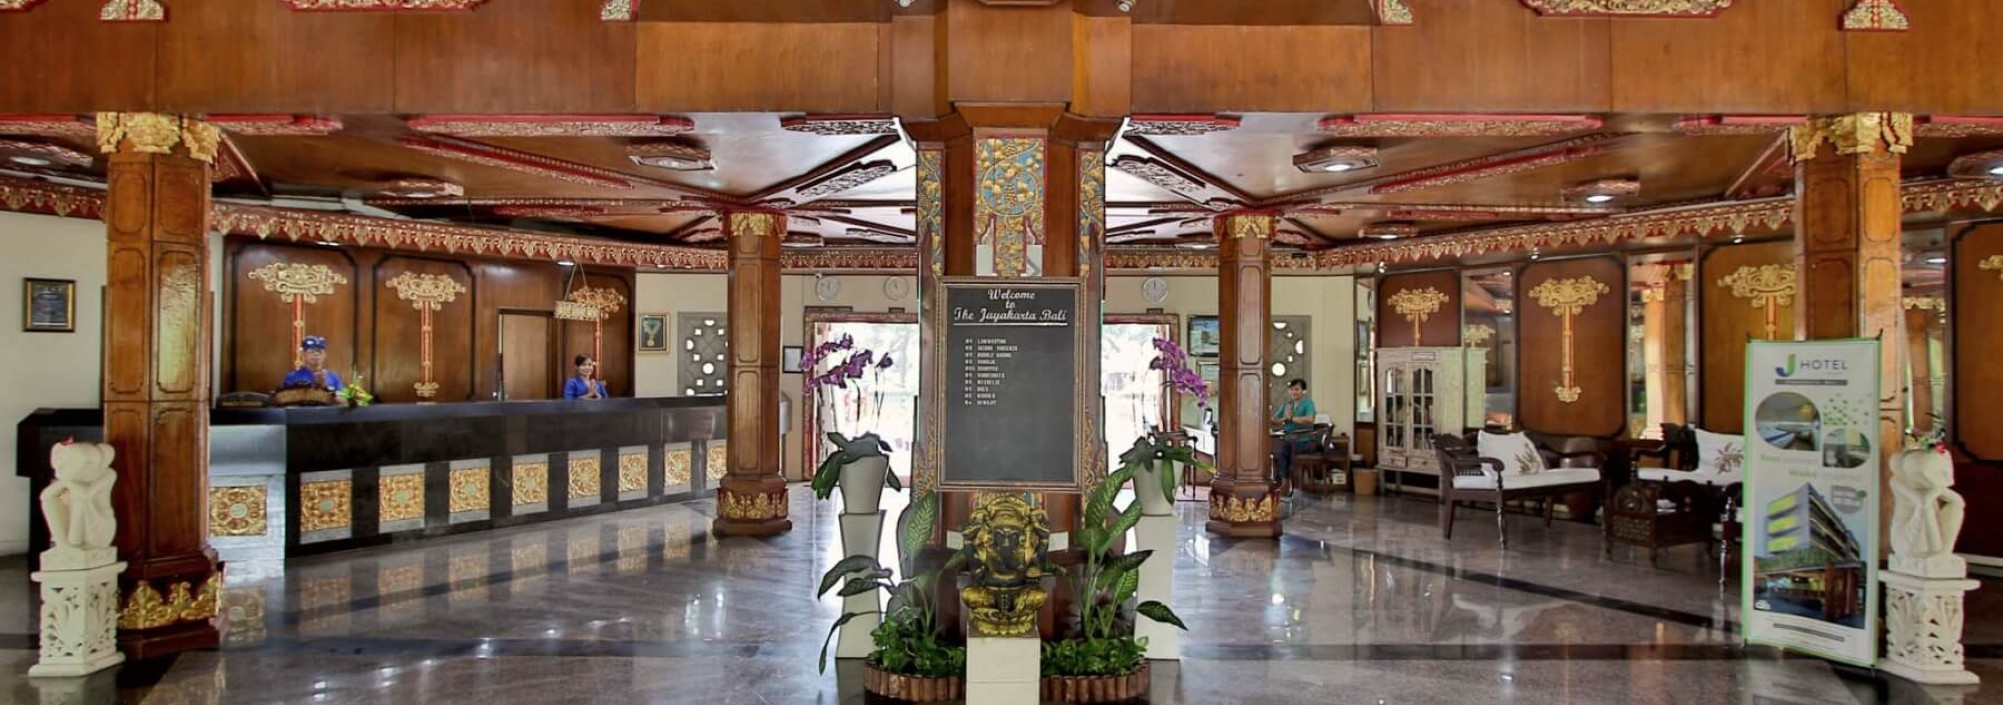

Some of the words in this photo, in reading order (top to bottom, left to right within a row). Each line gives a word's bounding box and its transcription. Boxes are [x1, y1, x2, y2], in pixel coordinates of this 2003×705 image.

[987, 289, 1036, 300] Welcome
[1005, 300, 1016, 309] to
[954, 307, 975, 321] The
[979, 308, 1037, 322] Jayakarta
[1039, 309, 1067, 321] Bali
[1800, 359, 1849, 370] HOTEL
